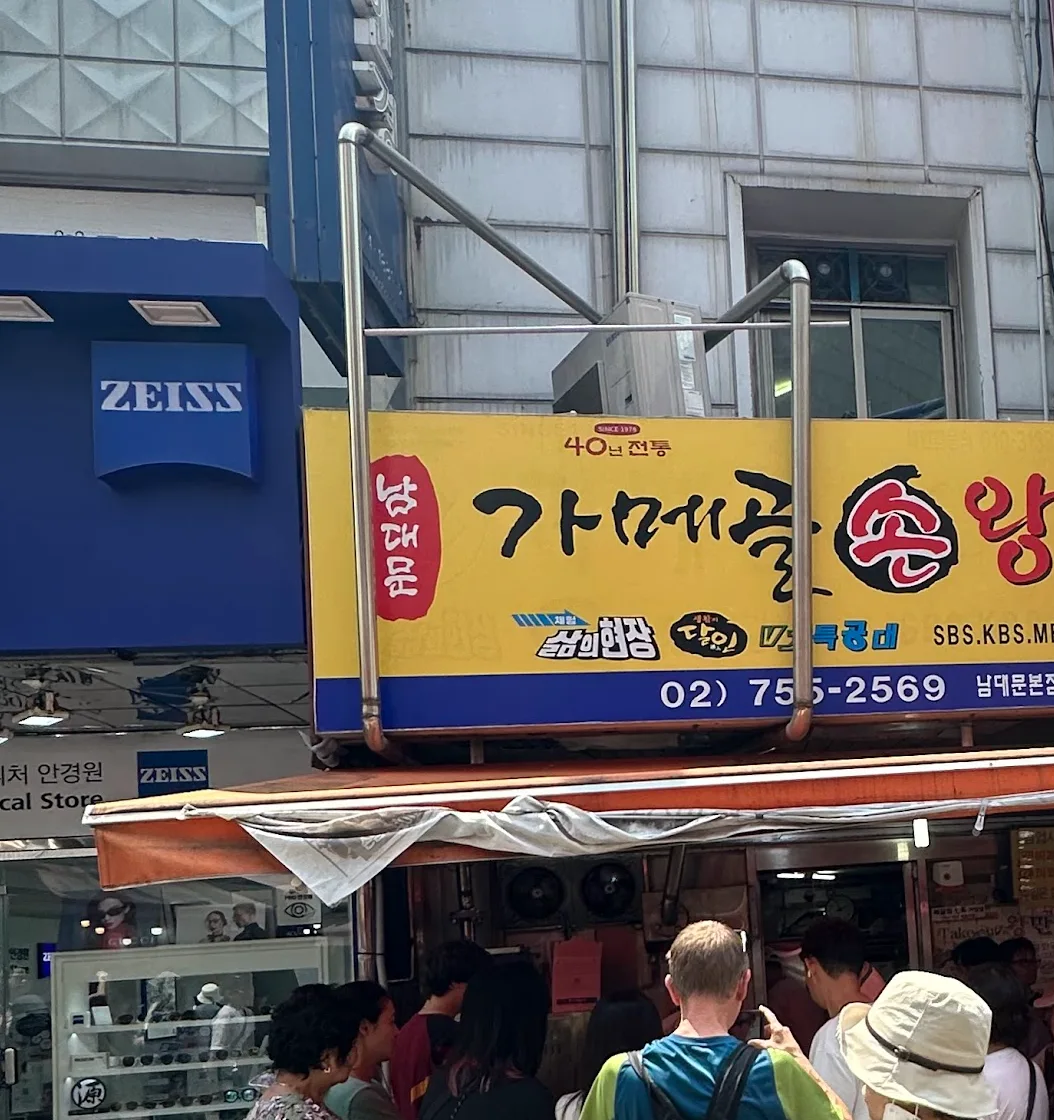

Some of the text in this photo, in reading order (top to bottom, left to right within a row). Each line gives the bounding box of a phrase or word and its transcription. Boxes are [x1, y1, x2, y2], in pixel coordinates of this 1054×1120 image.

[101, 380, 243, 413] ZEISS
[564, 437, 672, 457] 40년 전통
[376, 474, 419, 598] 남대문
[473, 469, 833, 604] 가메골
[846, 477, 951, 589] 손
[676, 623, 738, 653] 달인
[660, 680, 727, 709] 02)
[37, 761, 104, 784] 안경원
[140, 766, 207, 783] ZEISS
[41, 792, 104, 810] Store
[76, 1080, 102, 1106] 源
